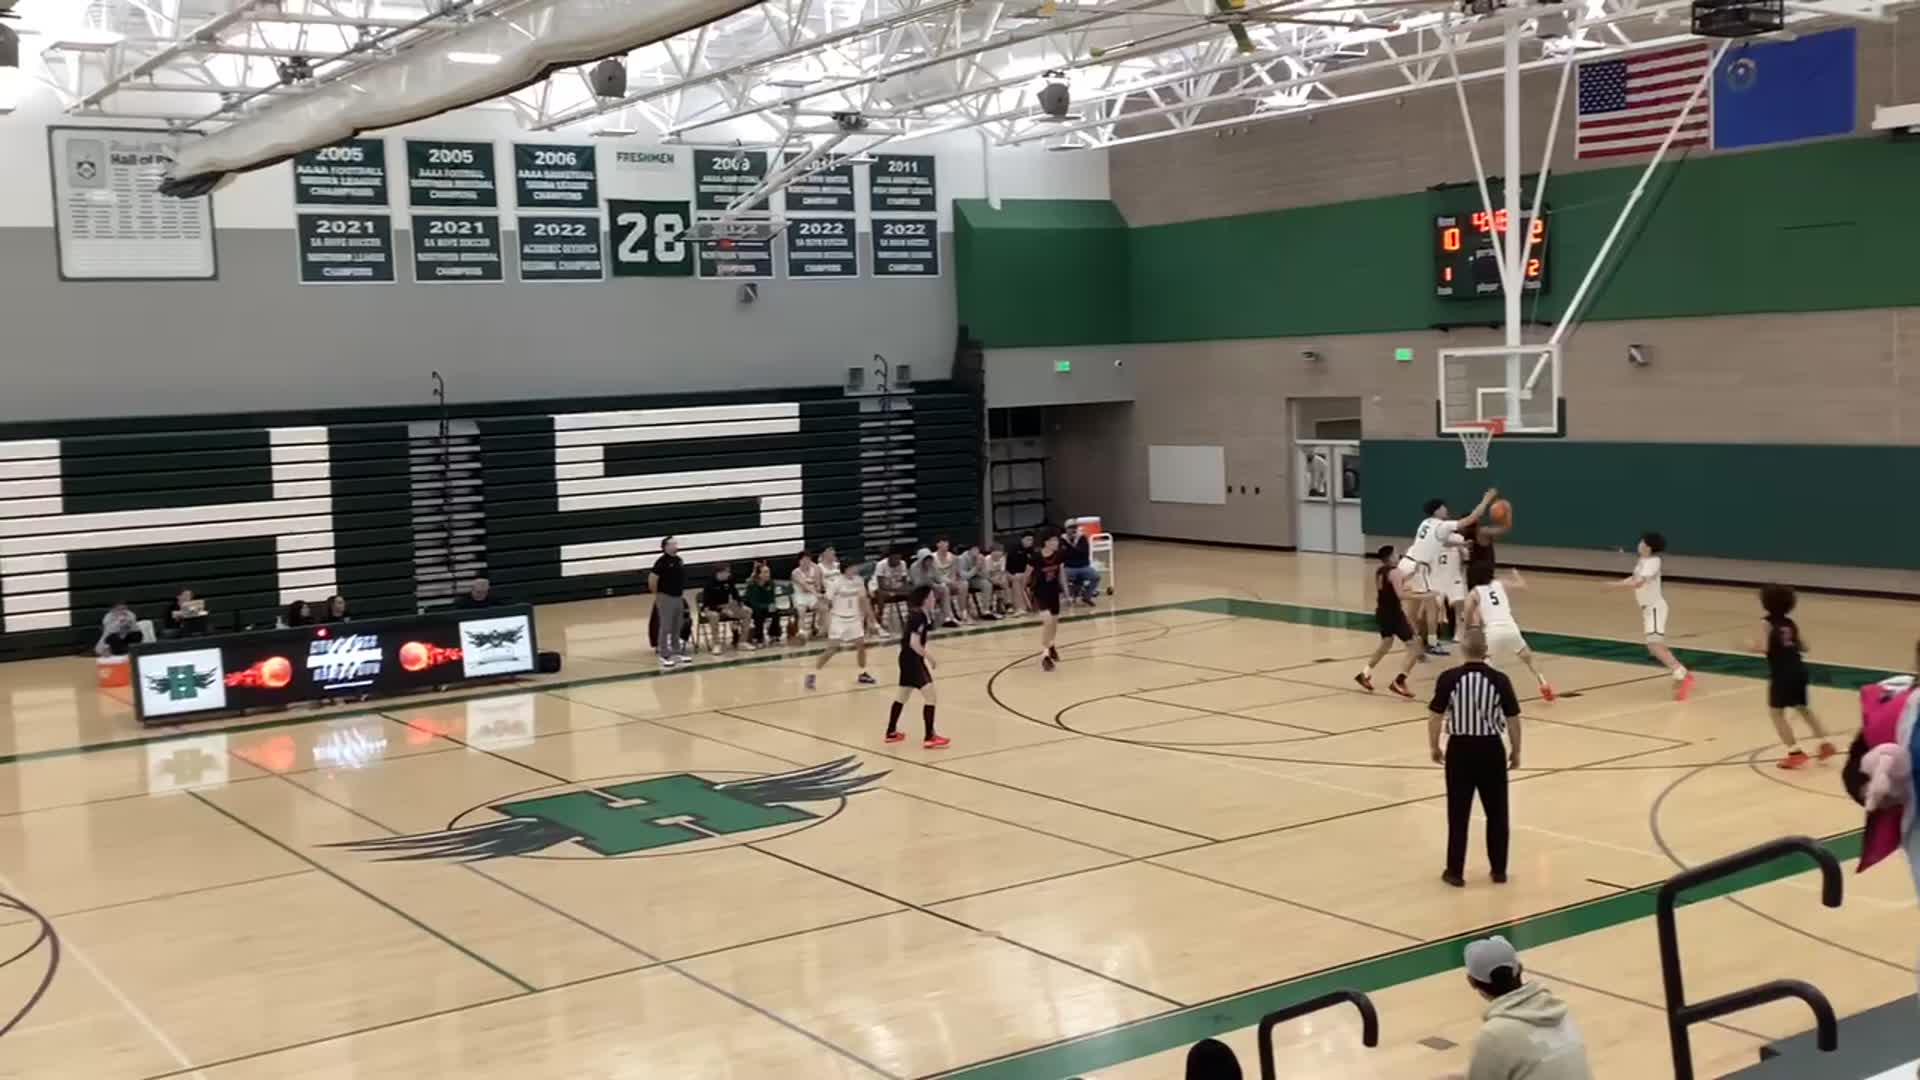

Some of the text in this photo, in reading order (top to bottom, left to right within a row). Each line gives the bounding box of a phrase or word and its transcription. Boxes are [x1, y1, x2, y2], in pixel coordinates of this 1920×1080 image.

[428, 149, 474, 163] 2005
[534, 151, 577, 166] 2006
[617, 152, 674, 163] FRESHMEN
[887, 160, 919, 173] 2011
[315, 220, 375, 234] 2021
[429, 221, 485, 235] 2021
[533, 223, 587, 236] 2022
[799, 222, 845, 236] 2022
[882, 223, 927, 236] 2022
[616, 211, 686, 263] 28
[1443, 227, 1461, 251] 0
[1444, 266, 1453, 281] 1
[1527, 258, 1541, 277] 2
[1489, 591, 1500, 607] 5
